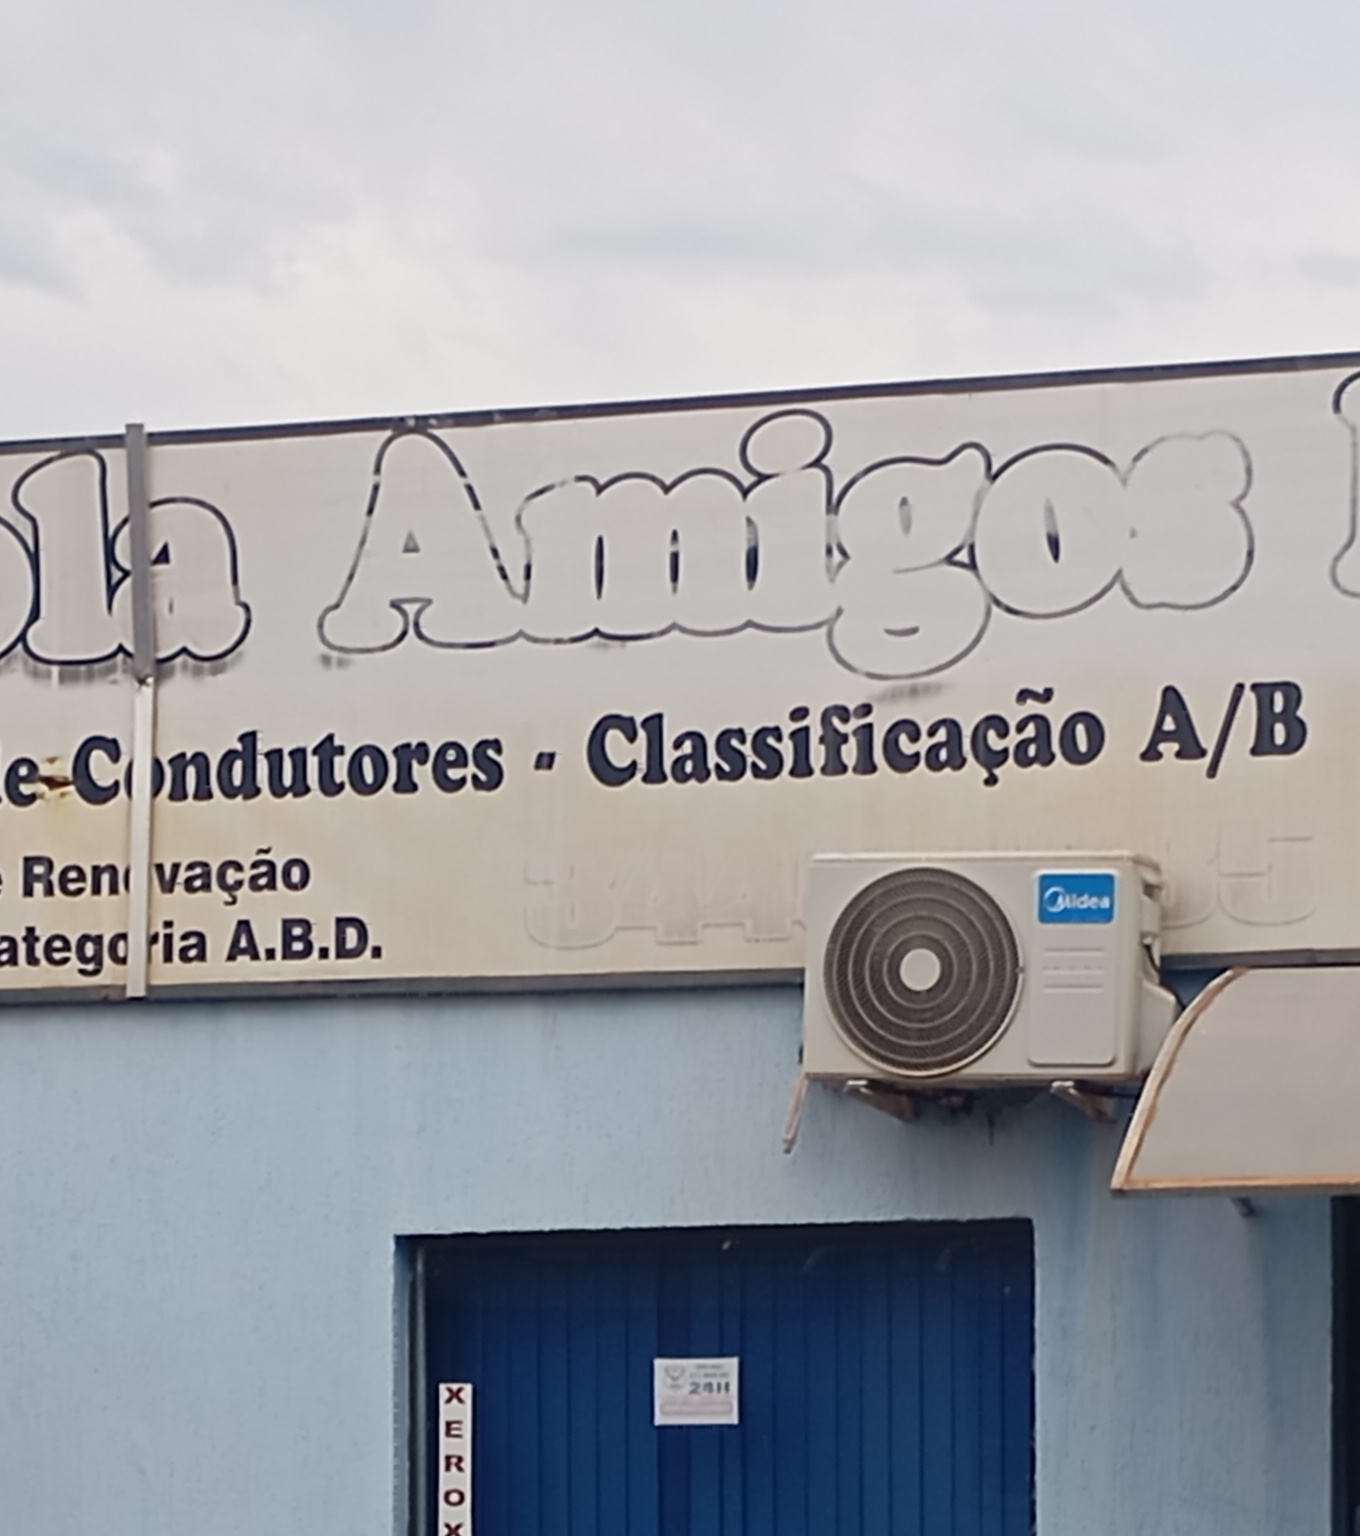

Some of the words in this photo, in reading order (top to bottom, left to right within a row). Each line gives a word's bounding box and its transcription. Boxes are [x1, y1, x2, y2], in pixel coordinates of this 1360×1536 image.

[318, 409, 1254, 680] Amigos
[587, 687, 1105, 787] Classificação
[1140, 681, 1307, 778] A/B
[23, 847, 311, 906] Renvação
[1043, 886, 1111, 913] Midea
[226, 917, 382, 964] A.B.D.
